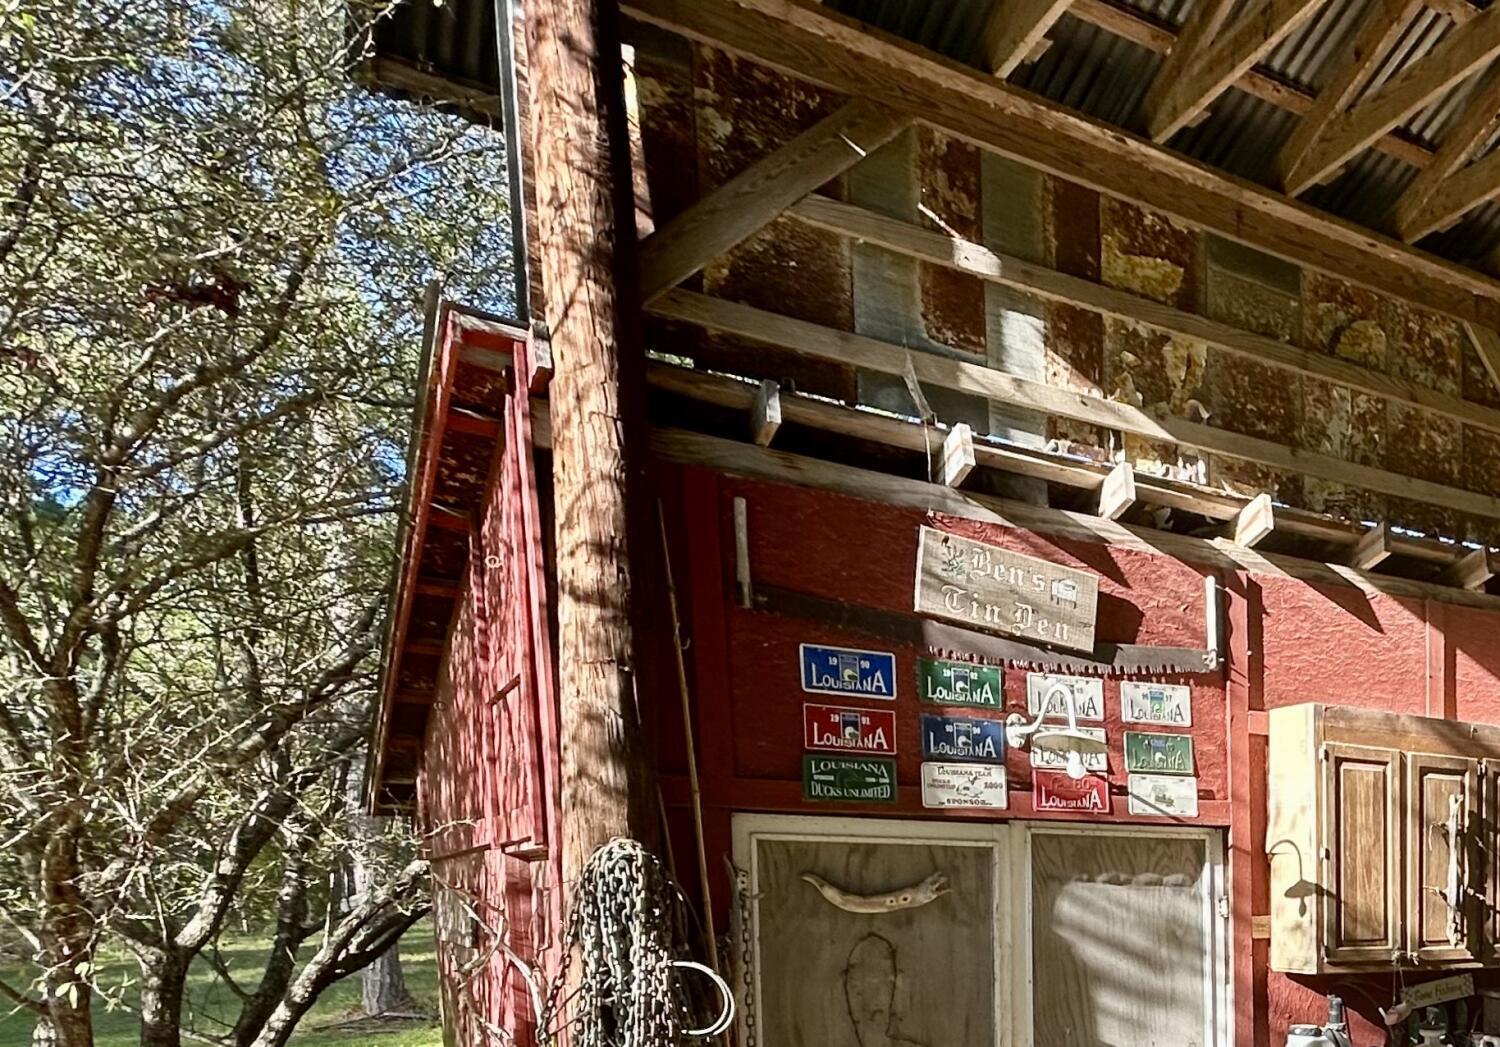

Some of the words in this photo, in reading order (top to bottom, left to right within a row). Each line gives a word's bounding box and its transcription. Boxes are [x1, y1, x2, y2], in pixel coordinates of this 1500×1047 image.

[969, 548, 1047, 592] Ben's
[941, 584, 1001, 623] Tin
[1010, 602, 1070, 640] Den
[811, 662, 888, 693] LOUISIANA
[927, 676, 995, 704] LOUISIANA
[1130, 699, 1185, 722] LOUISIANA
[813, 722, 889, 749] LOUISIANA
[929, 731, 997, 758] LOUISIANA
[811, 760, 889, 778] LOUISIANA
[811, 781, 843, 797] DUCKS
[843, 784, 890, 799] UNLIMITED
[1041, 786, 1103, 809] LOUISIANA
